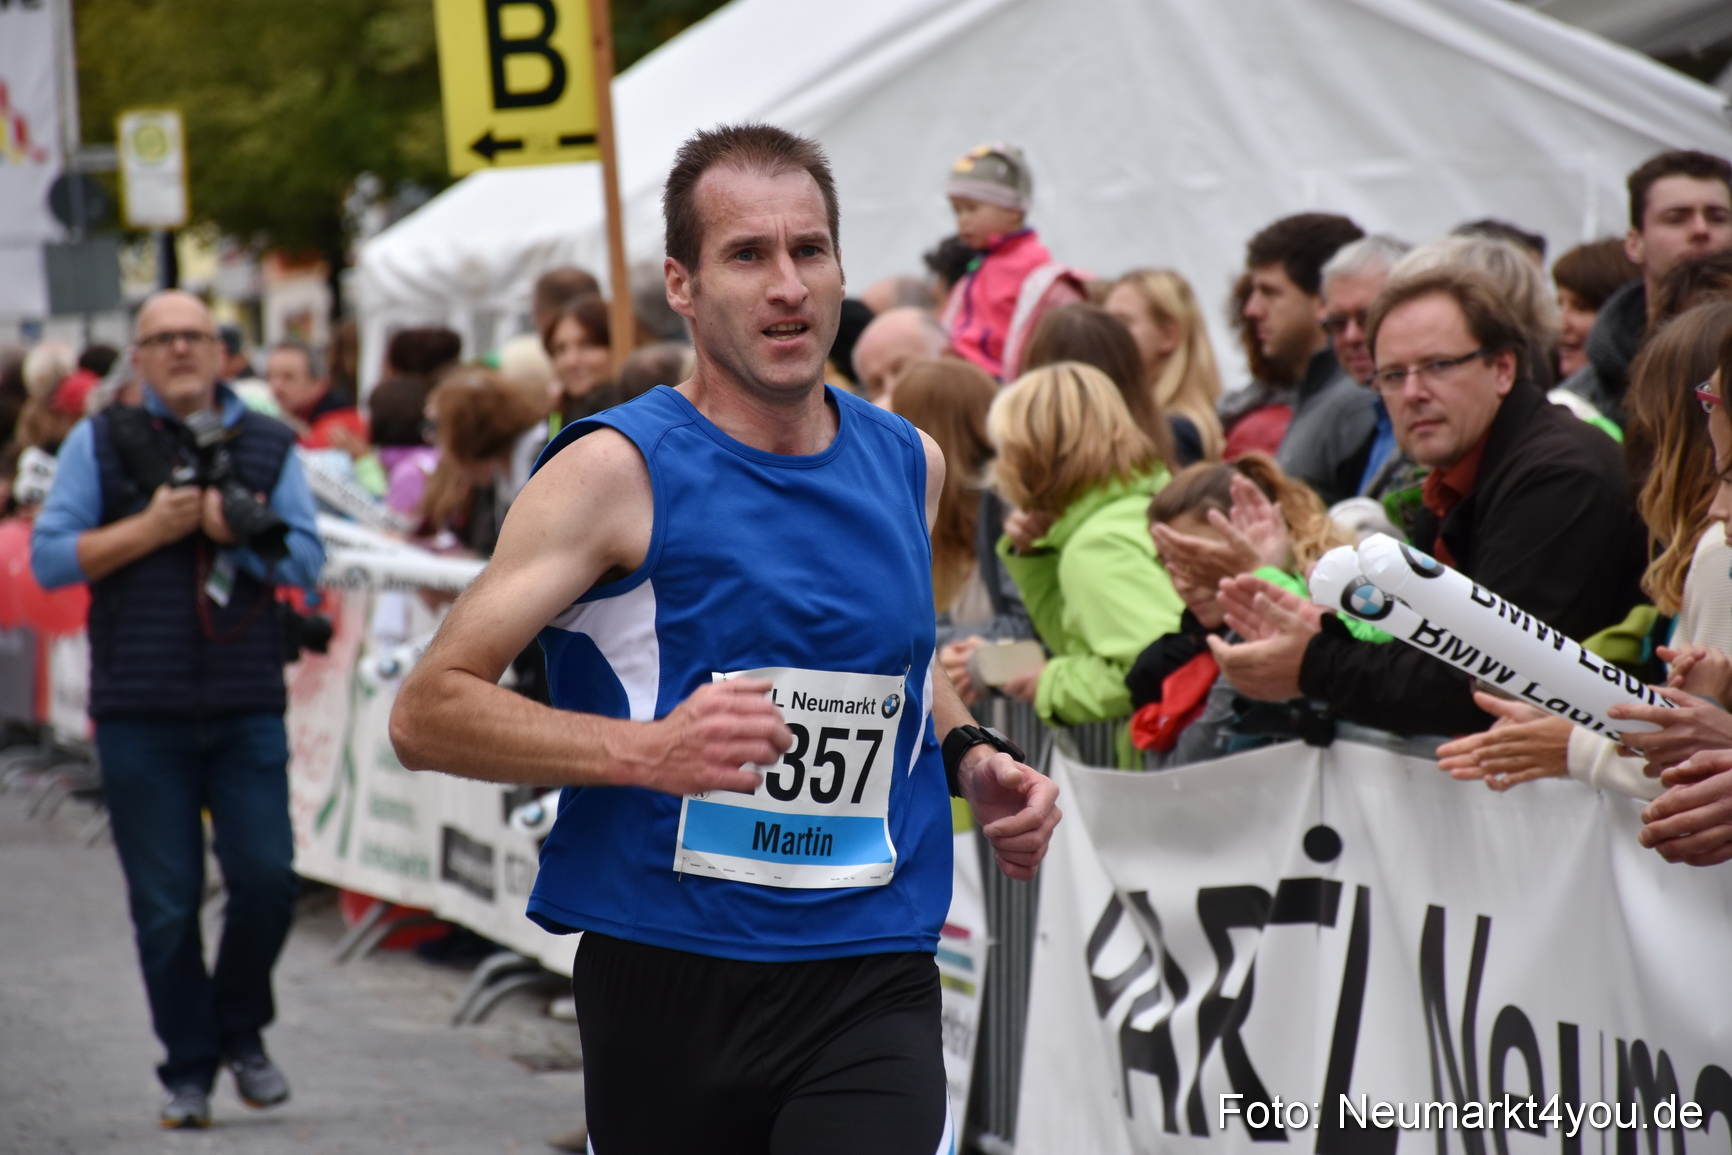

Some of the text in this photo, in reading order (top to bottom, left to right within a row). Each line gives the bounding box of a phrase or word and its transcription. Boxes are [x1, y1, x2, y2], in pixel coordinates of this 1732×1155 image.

[485, 0, 569, 109] B
[791, 690, 876, 716] Neumarkt
[719, 723, 884, 805] 357
[751, 821, 834, 857] Martin
